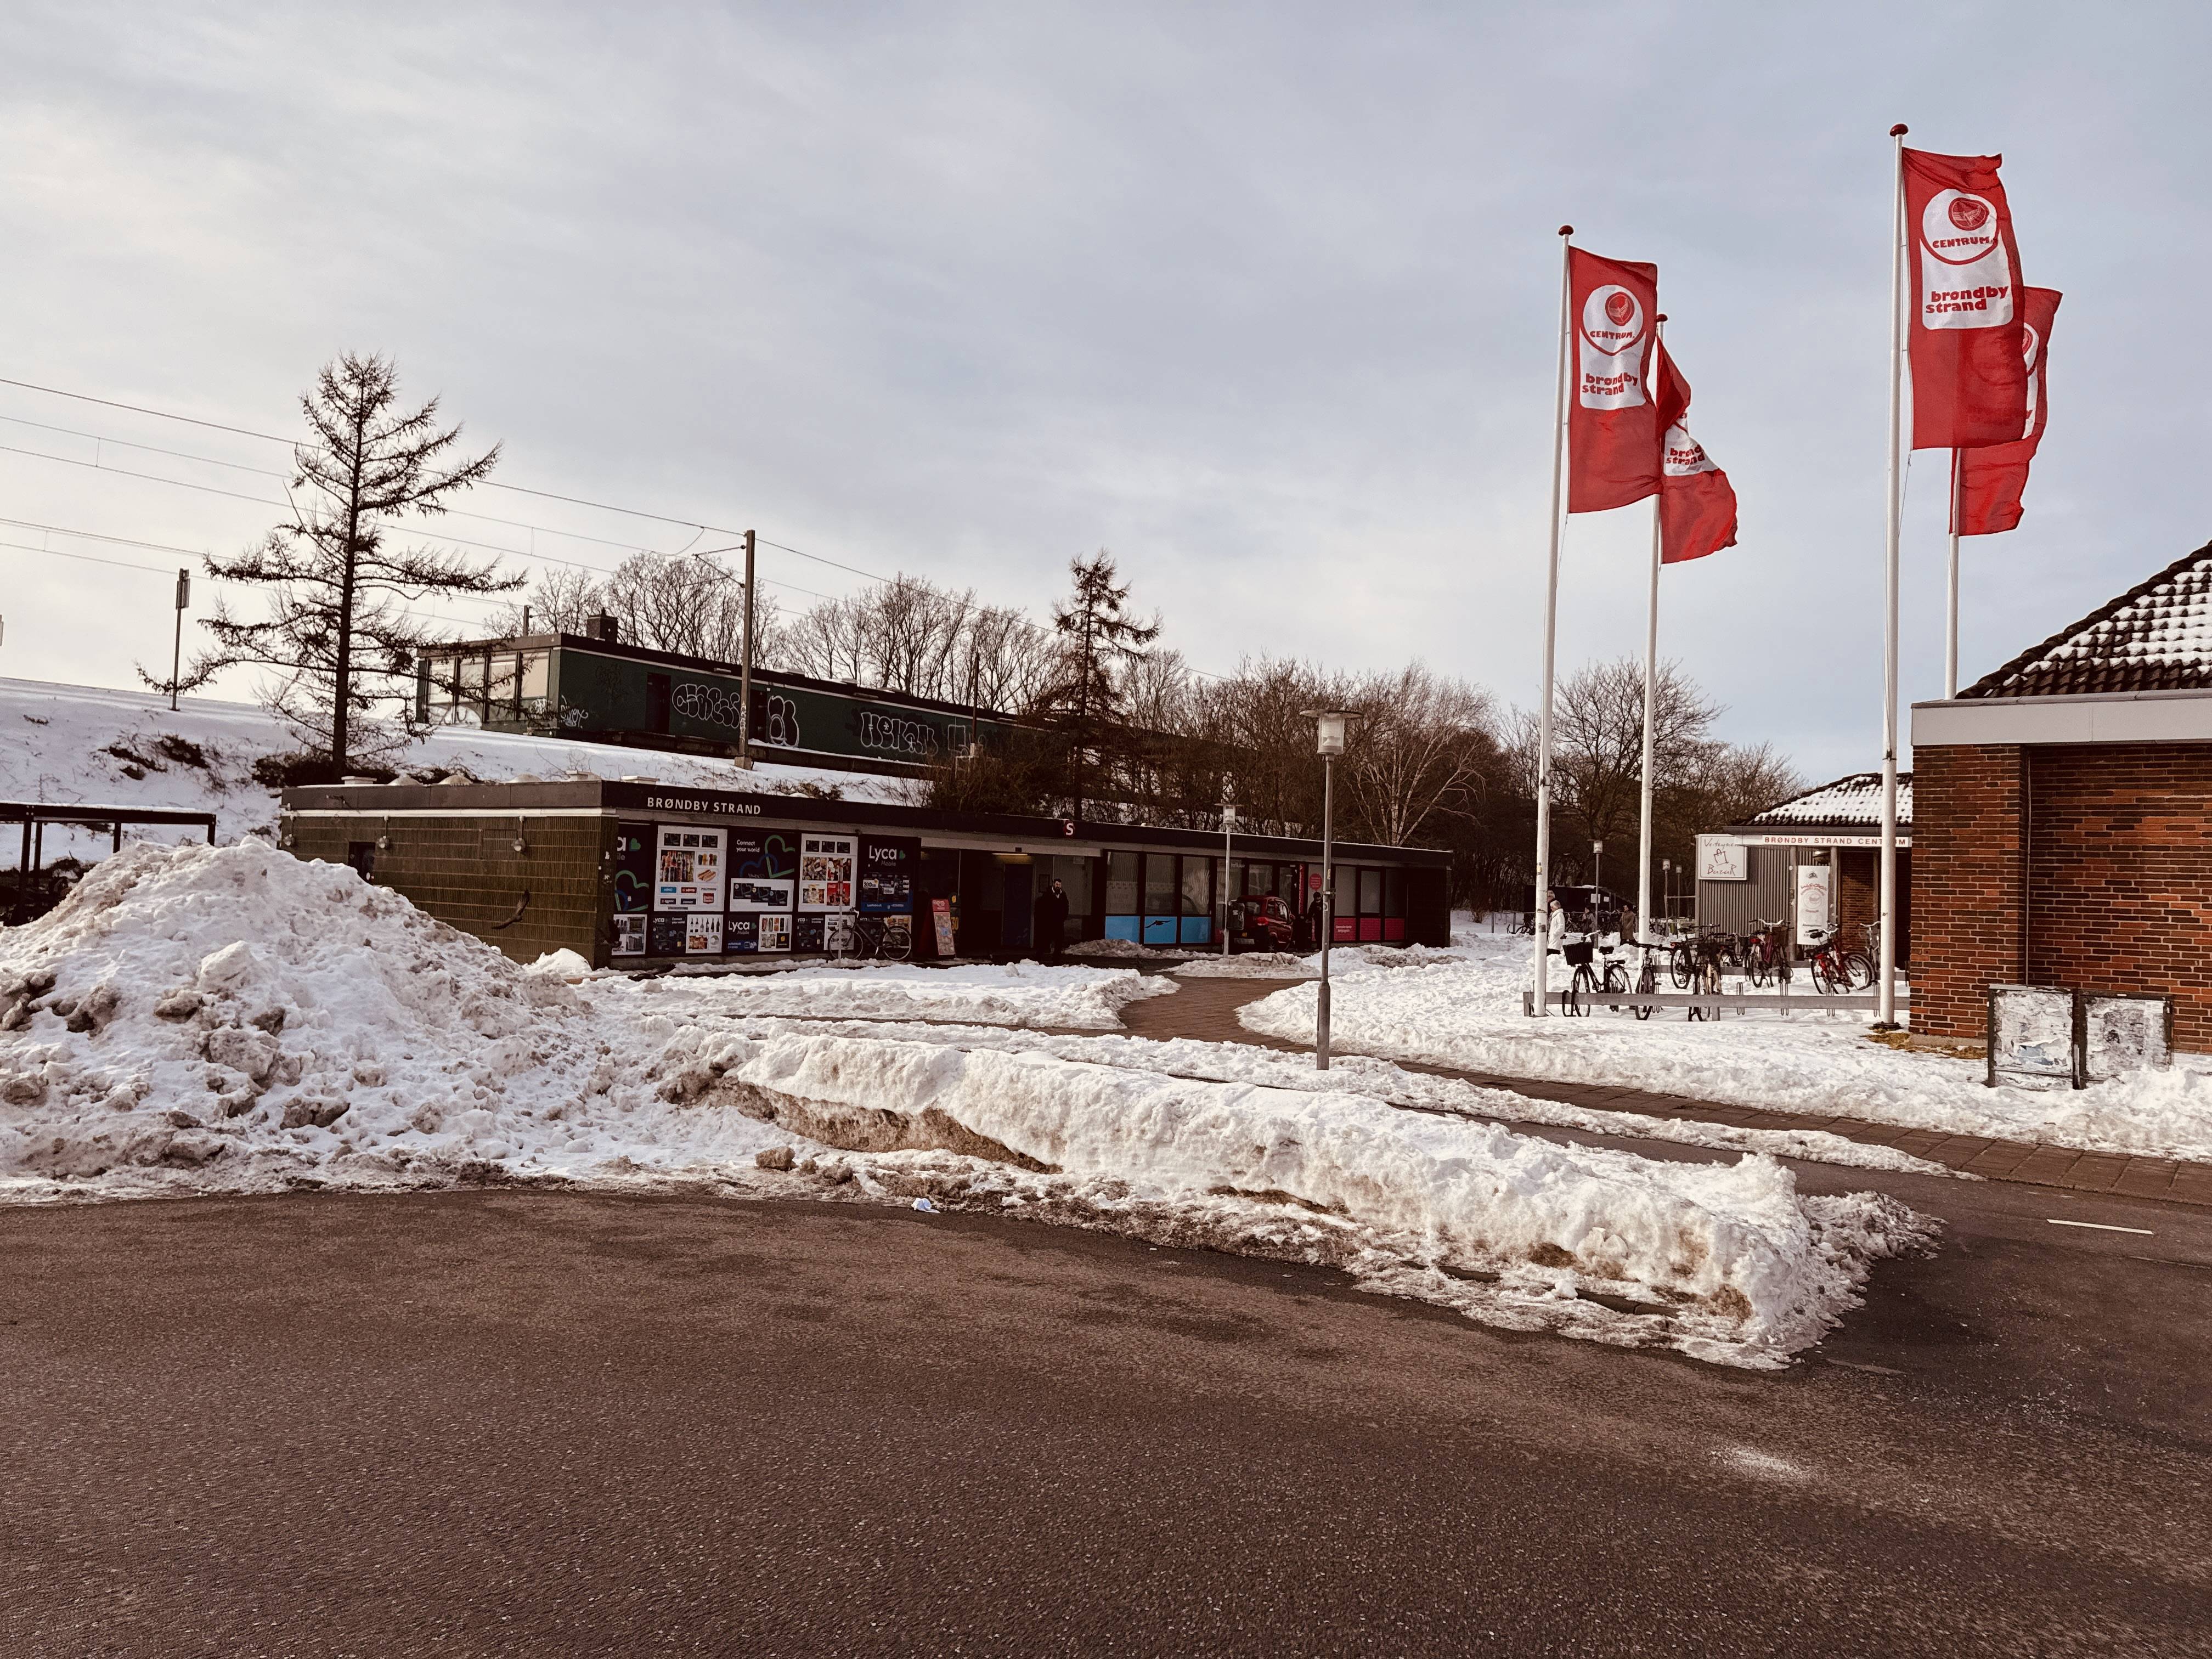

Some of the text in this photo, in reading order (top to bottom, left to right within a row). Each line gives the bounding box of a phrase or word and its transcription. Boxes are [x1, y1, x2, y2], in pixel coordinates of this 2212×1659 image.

[1926, 298, 1987, 313] strand
[1582, 382, 1624, 396] strand
[1666, 452, 1705, 465] strand
[647, 797, 761, 815] BRØNDBY STRAND
[1065, 822, 1074, 836] S
[869, 845, 897, 862] Lyca
[728, 920, 750, 932] Lyca
